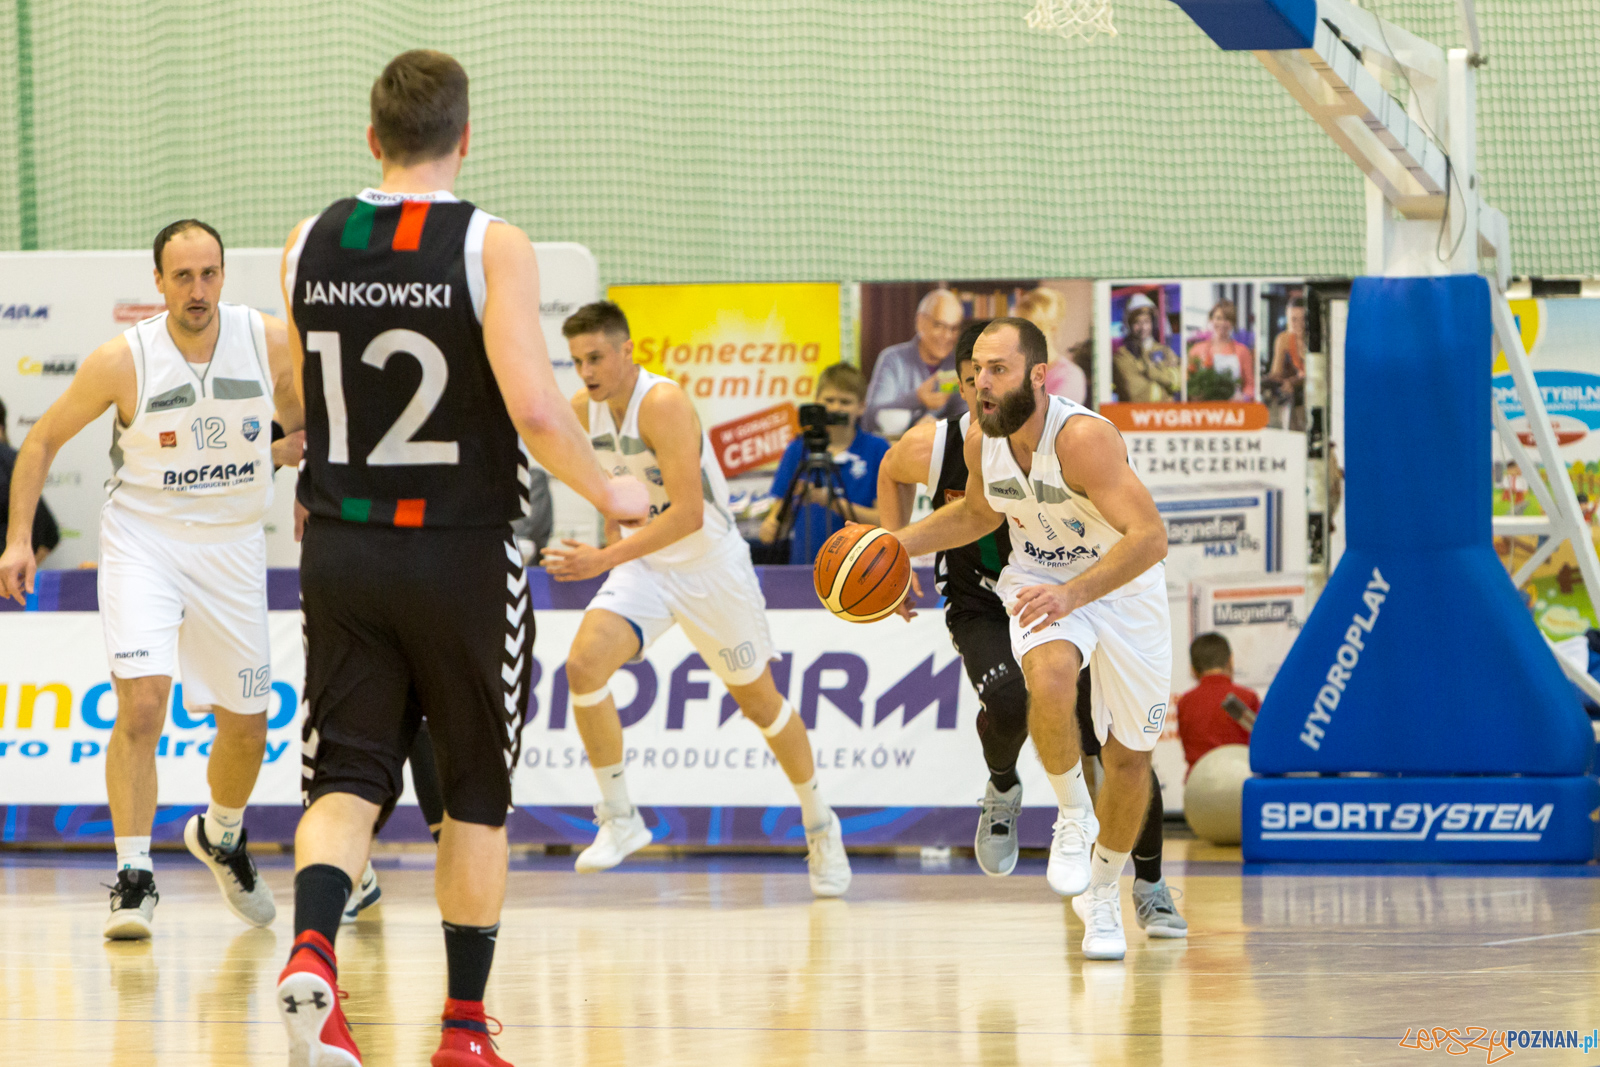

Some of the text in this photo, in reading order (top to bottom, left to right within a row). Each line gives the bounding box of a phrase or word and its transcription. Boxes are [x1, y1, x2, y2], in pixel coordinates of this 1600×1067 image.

[304, 281, 452, 308] JANKOWSKI
[637, 337, 821, 365] Słoneczna
[151, 396, 187, 409] macron
[306, 328, 460, 466] 12
[1131, 409, 1245, 426] WYGRYWAJ
[191, 416, 227, 450] 12
[723, 425, 791, 468] CENIE
[1133, 438, 1262, 451] ZE STRESEM
[164, 461, 254, 485] BIOFARM
[1149, 457, 1287, 475] ZMĘCZENIEM
[1165, 516, 1239, 543] agnefar
[1204, 542, 1238, 557] MAX
[115, 649, 149, 659] macron
[719, 641, 756, 672] 10
[1300, 567, 1390, 750] HYDROPLAY
[239, 665, 270, 698] 12
[1144, 703, 1167, 733] 9
[625, 747, 778, 769] PRODUCEN
[816, 743, 915, 769] LEKÓW
